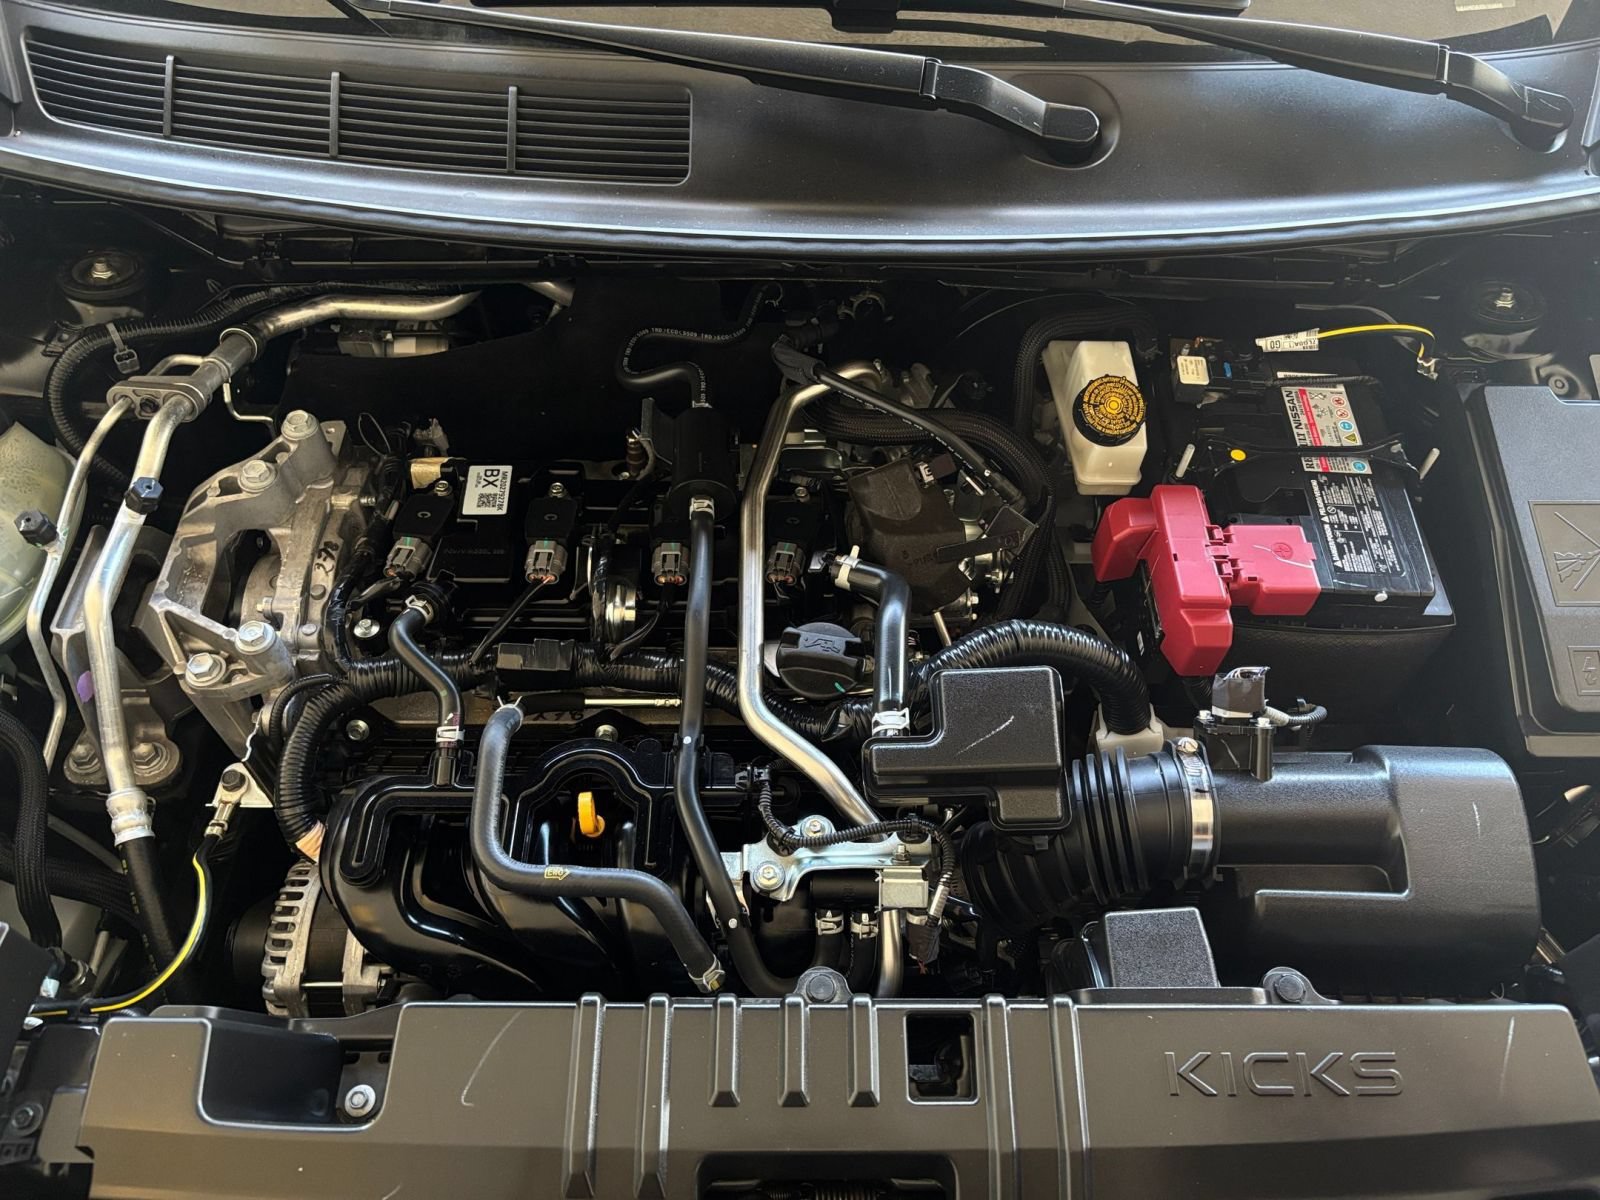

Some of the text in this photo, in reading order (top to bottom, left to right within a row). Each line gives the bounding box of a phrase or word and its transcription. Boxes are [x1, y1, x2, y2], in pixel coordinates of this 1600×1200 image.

[1284, 390, 1304, 430] NISSAN
[482, 469, 501, 488] BX
[1164, 1051, 1403, 1097] KICKS
